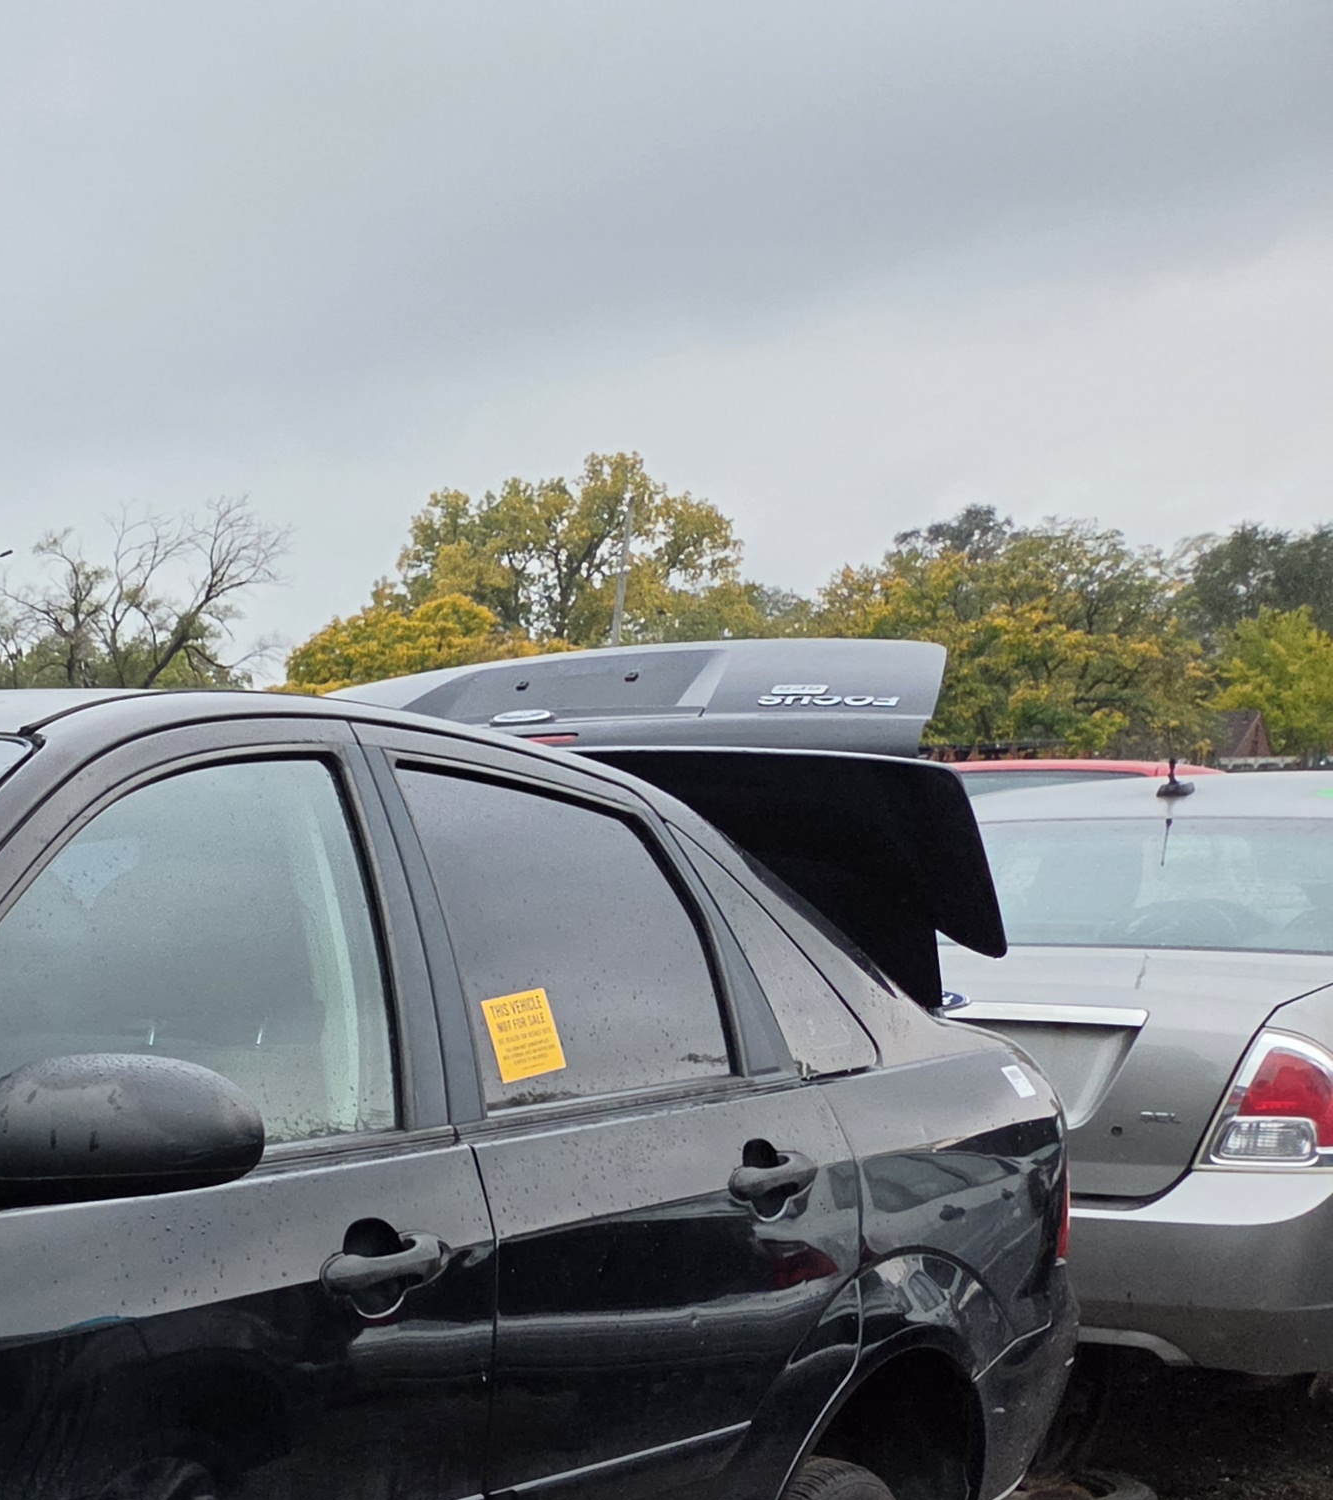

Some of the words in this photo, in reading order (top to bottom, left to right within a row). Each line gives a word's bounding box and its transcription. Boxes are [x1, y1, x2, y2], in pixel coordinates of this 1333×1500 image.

[757, 695, 900, 707] FOCUS
[490, 1003, 510, 1019] THIS
[509, 995, 543, 1014] VEHICLE
[496, 1020, 512, 1033] NOT
[513, 1017, 527, 1030] FOR
[527, 1012, 546, 1026] SALE
